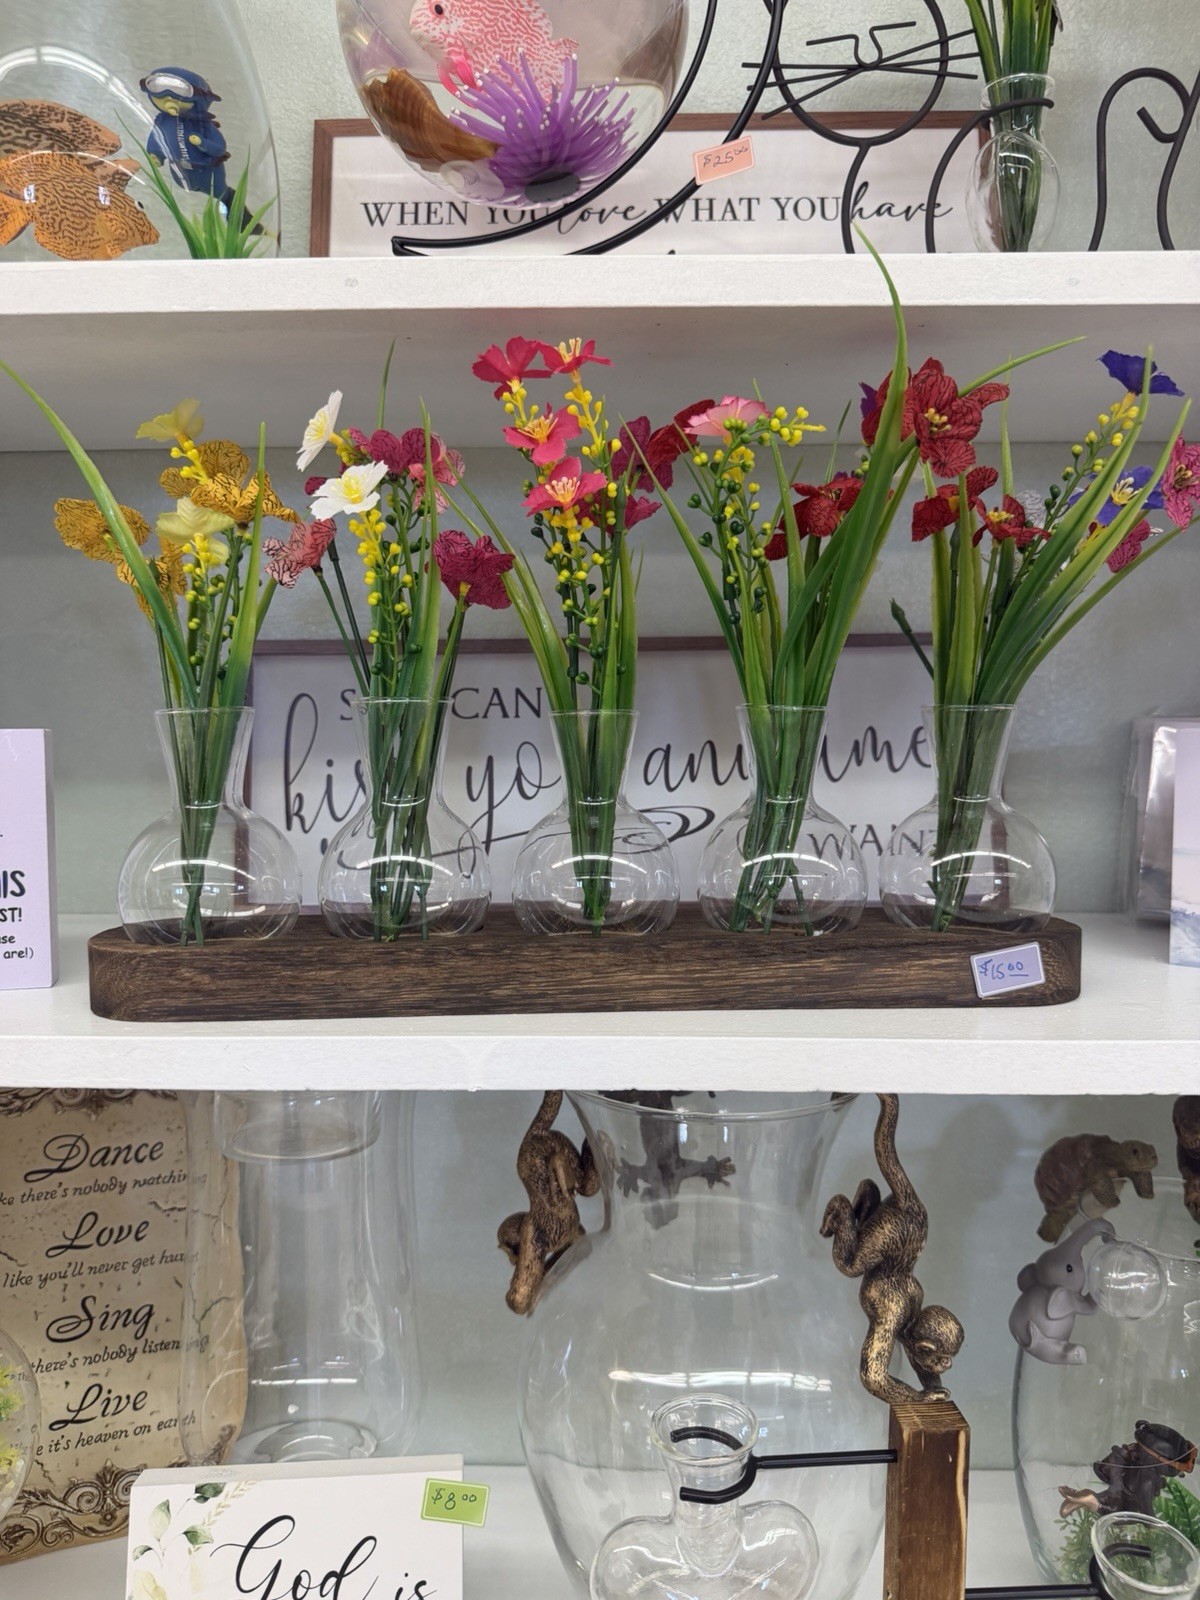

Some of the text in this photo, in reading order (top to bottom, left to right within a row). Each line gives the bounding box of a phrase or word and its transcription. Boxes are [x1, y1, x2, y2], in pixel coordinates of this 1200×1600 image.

[361, 201, 468, 227] WHEN
[654, 197, 759, 224] WHAT
[771, 196, 841, 222] YOU
[849, 180, 954, 223] have
[451, 687, 542, 720] CAN
[3, 946, 34, 959] are!)
[23, 1133, 165, 1183] Dance
[20, 1182, 68, 1204] there's
[73, 1176, 128, 1197] nobody
[45, 1211, 150, 1258] Love
[3, 1272, 33, 1288] like
[38, 1262, 83, 1288] you'll
[88, 1259, 129, 1275] never
[132, 1253, 156, 1274] get
[46, 1295, 156, 1343] Sing
[83, 1344, 138, 1364] nobody
[49, 1383, 148, 1431] Live
[48, 1434, 71, 1453] it's
[75, 1422, 130, 1449] heaven
[133, 1419, 152, 1437] on
[210, 1515, 378, 1600] God
